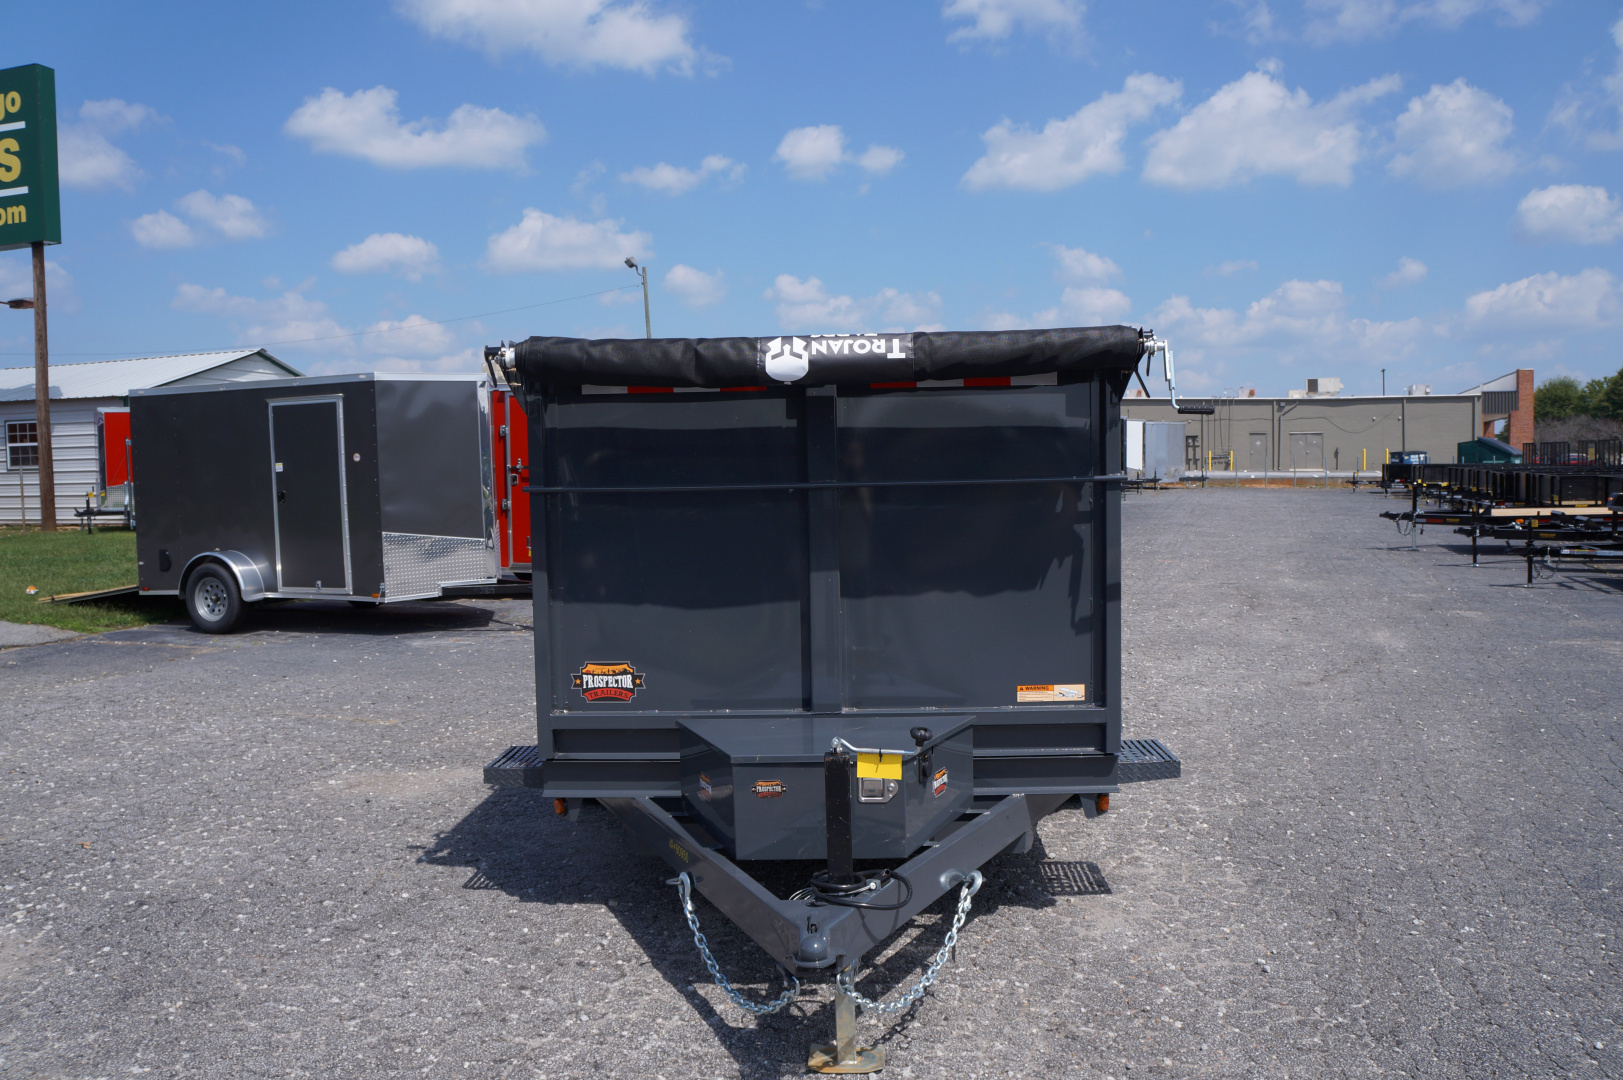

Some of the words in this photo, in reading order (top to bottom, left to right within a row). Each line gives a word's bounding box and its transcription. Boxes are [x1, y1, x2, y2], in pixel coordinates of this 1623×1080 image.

[812, 338, 906, 359] TROJAN
[582, 674, 634, 689] PROSPECTOR
[587, 689, 630, 699] TRAILERS
